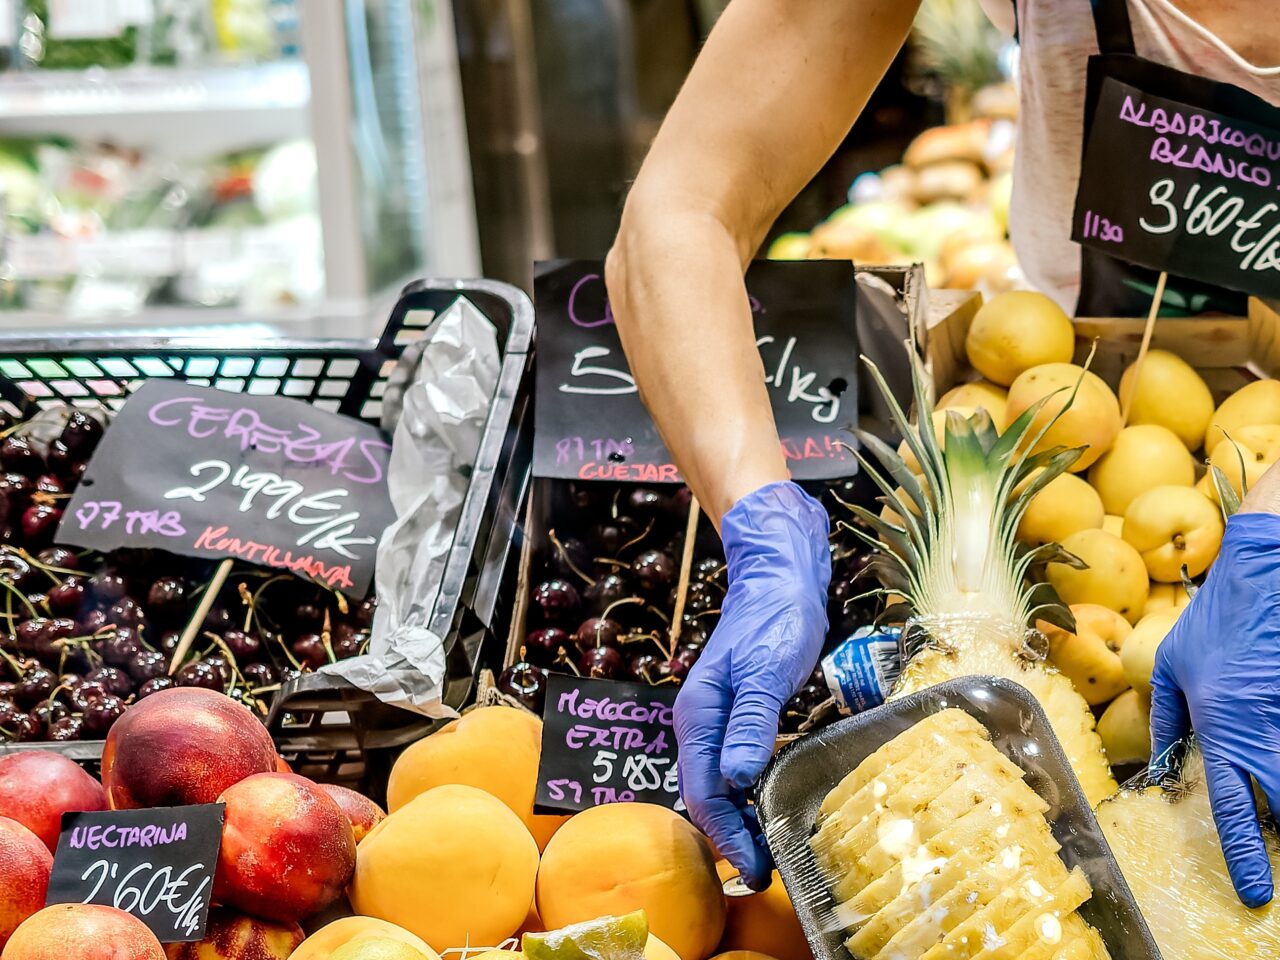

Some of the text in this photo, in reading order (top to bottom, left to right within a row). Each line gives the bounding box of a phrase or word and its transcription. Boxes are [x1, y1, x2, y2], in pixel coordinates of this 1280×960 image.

[149, 396, 392, 485] CEREZAS
[557, 687, 674, 726] MELOCOTO
[565, 724, 669, 754] EXTRA
[70, 822, 188, 850] NECTARINA
